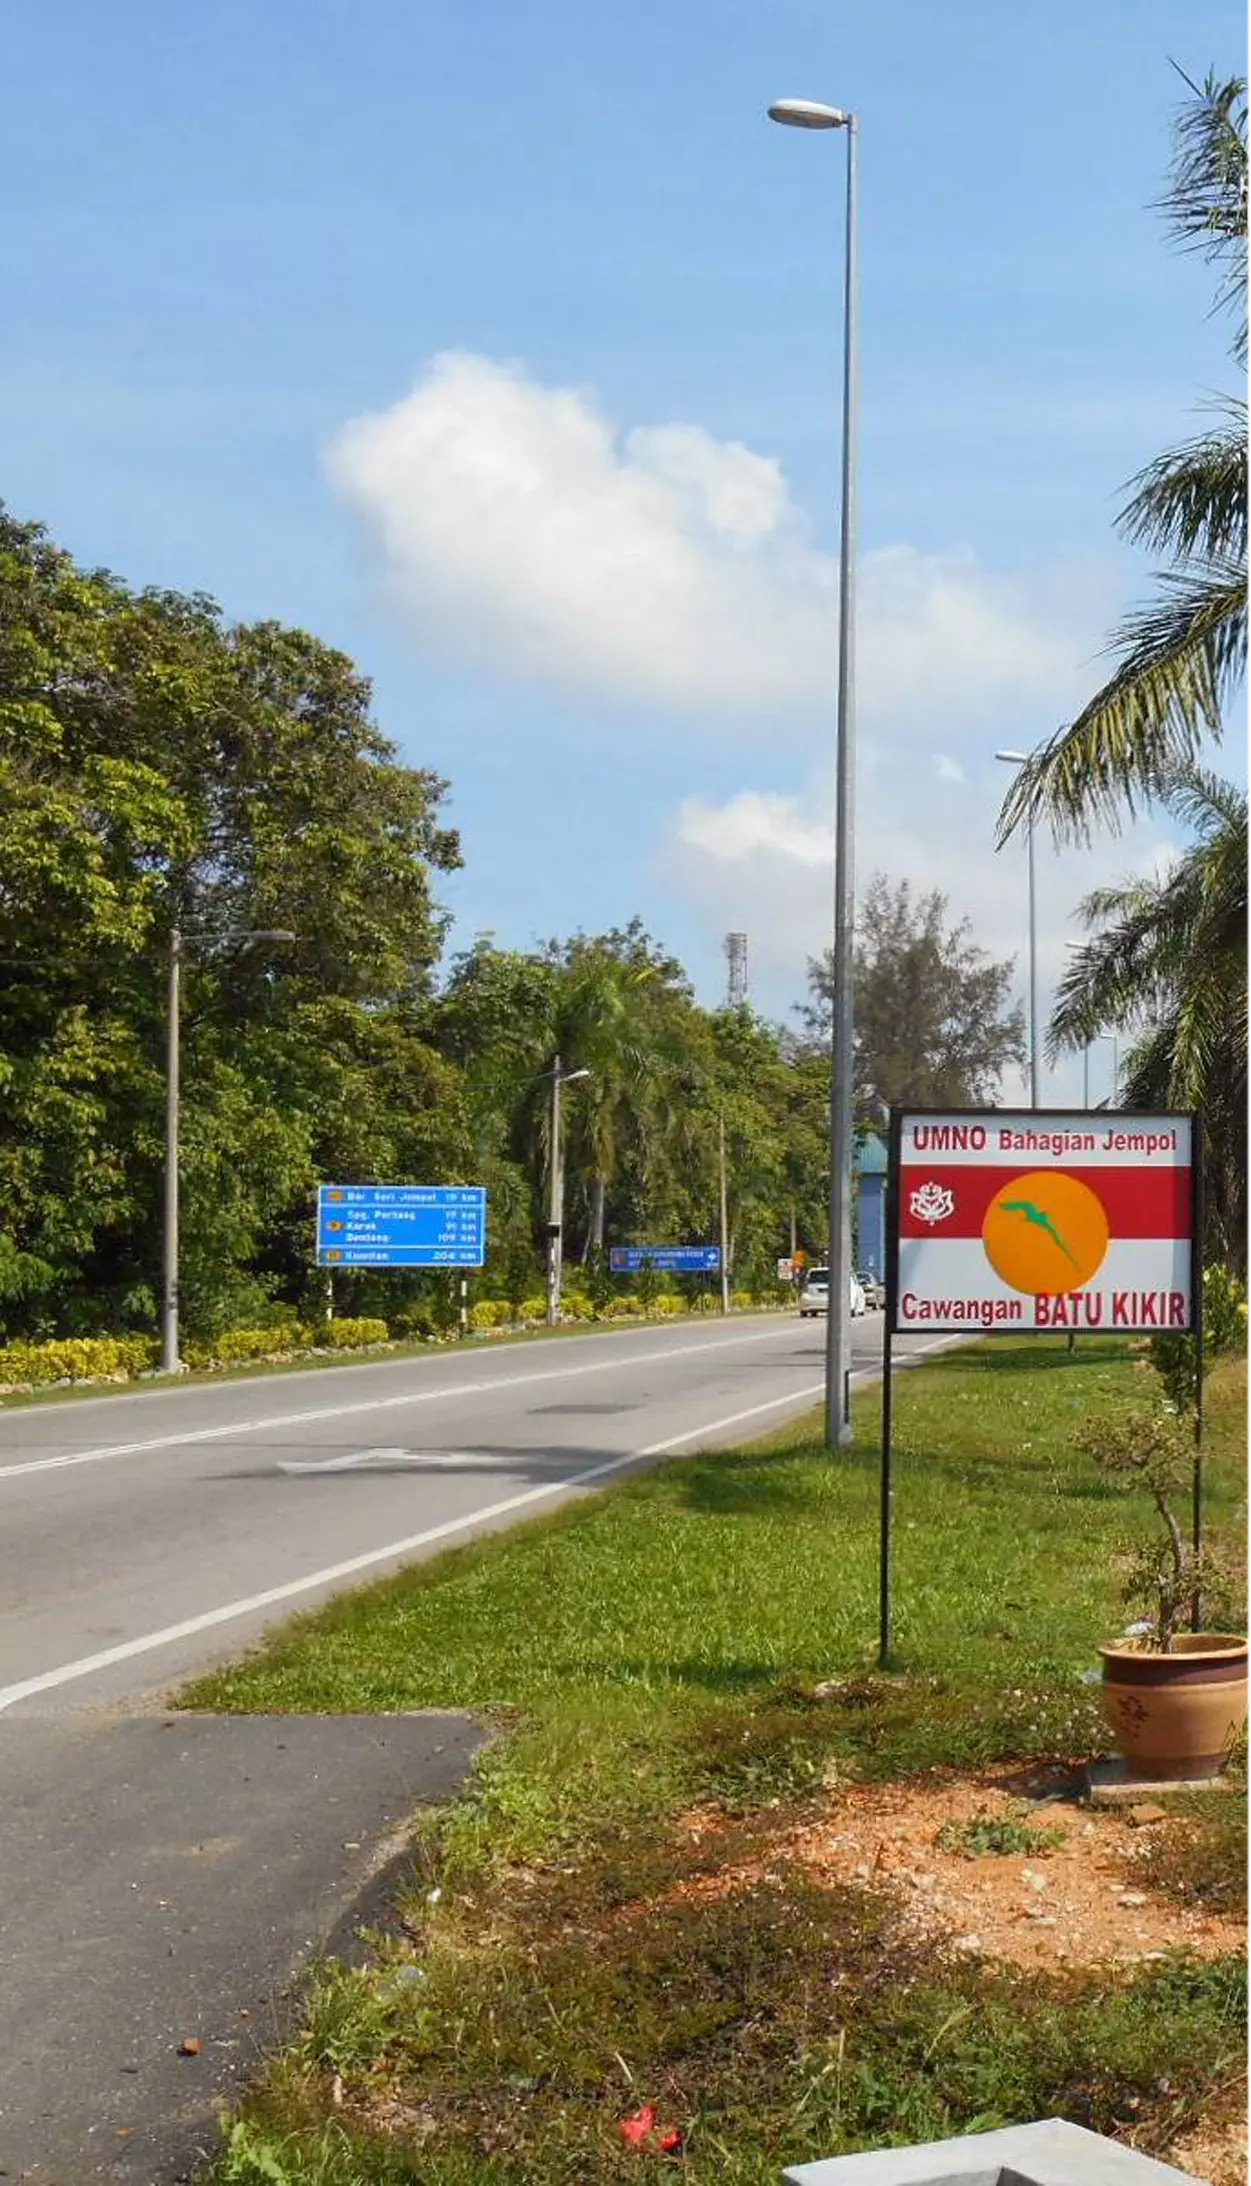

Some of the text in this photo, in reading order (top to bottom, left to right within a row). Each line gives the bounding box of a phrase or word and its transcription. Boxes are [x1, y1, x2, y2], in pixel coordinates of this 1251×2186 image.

[913, 1125, 1177, 1156] UMNO Bahagian Jempol
[462, 1193, 477, 1201] km
[461, 1211, 477, 1220] km
[461, 1222, 477, 1231] km
[460, 1233, 477, 1242] km
[460, 1251, 477, 1260] km
[902, 1291, 1186, 1326] Cawangan BATU KIKIR
